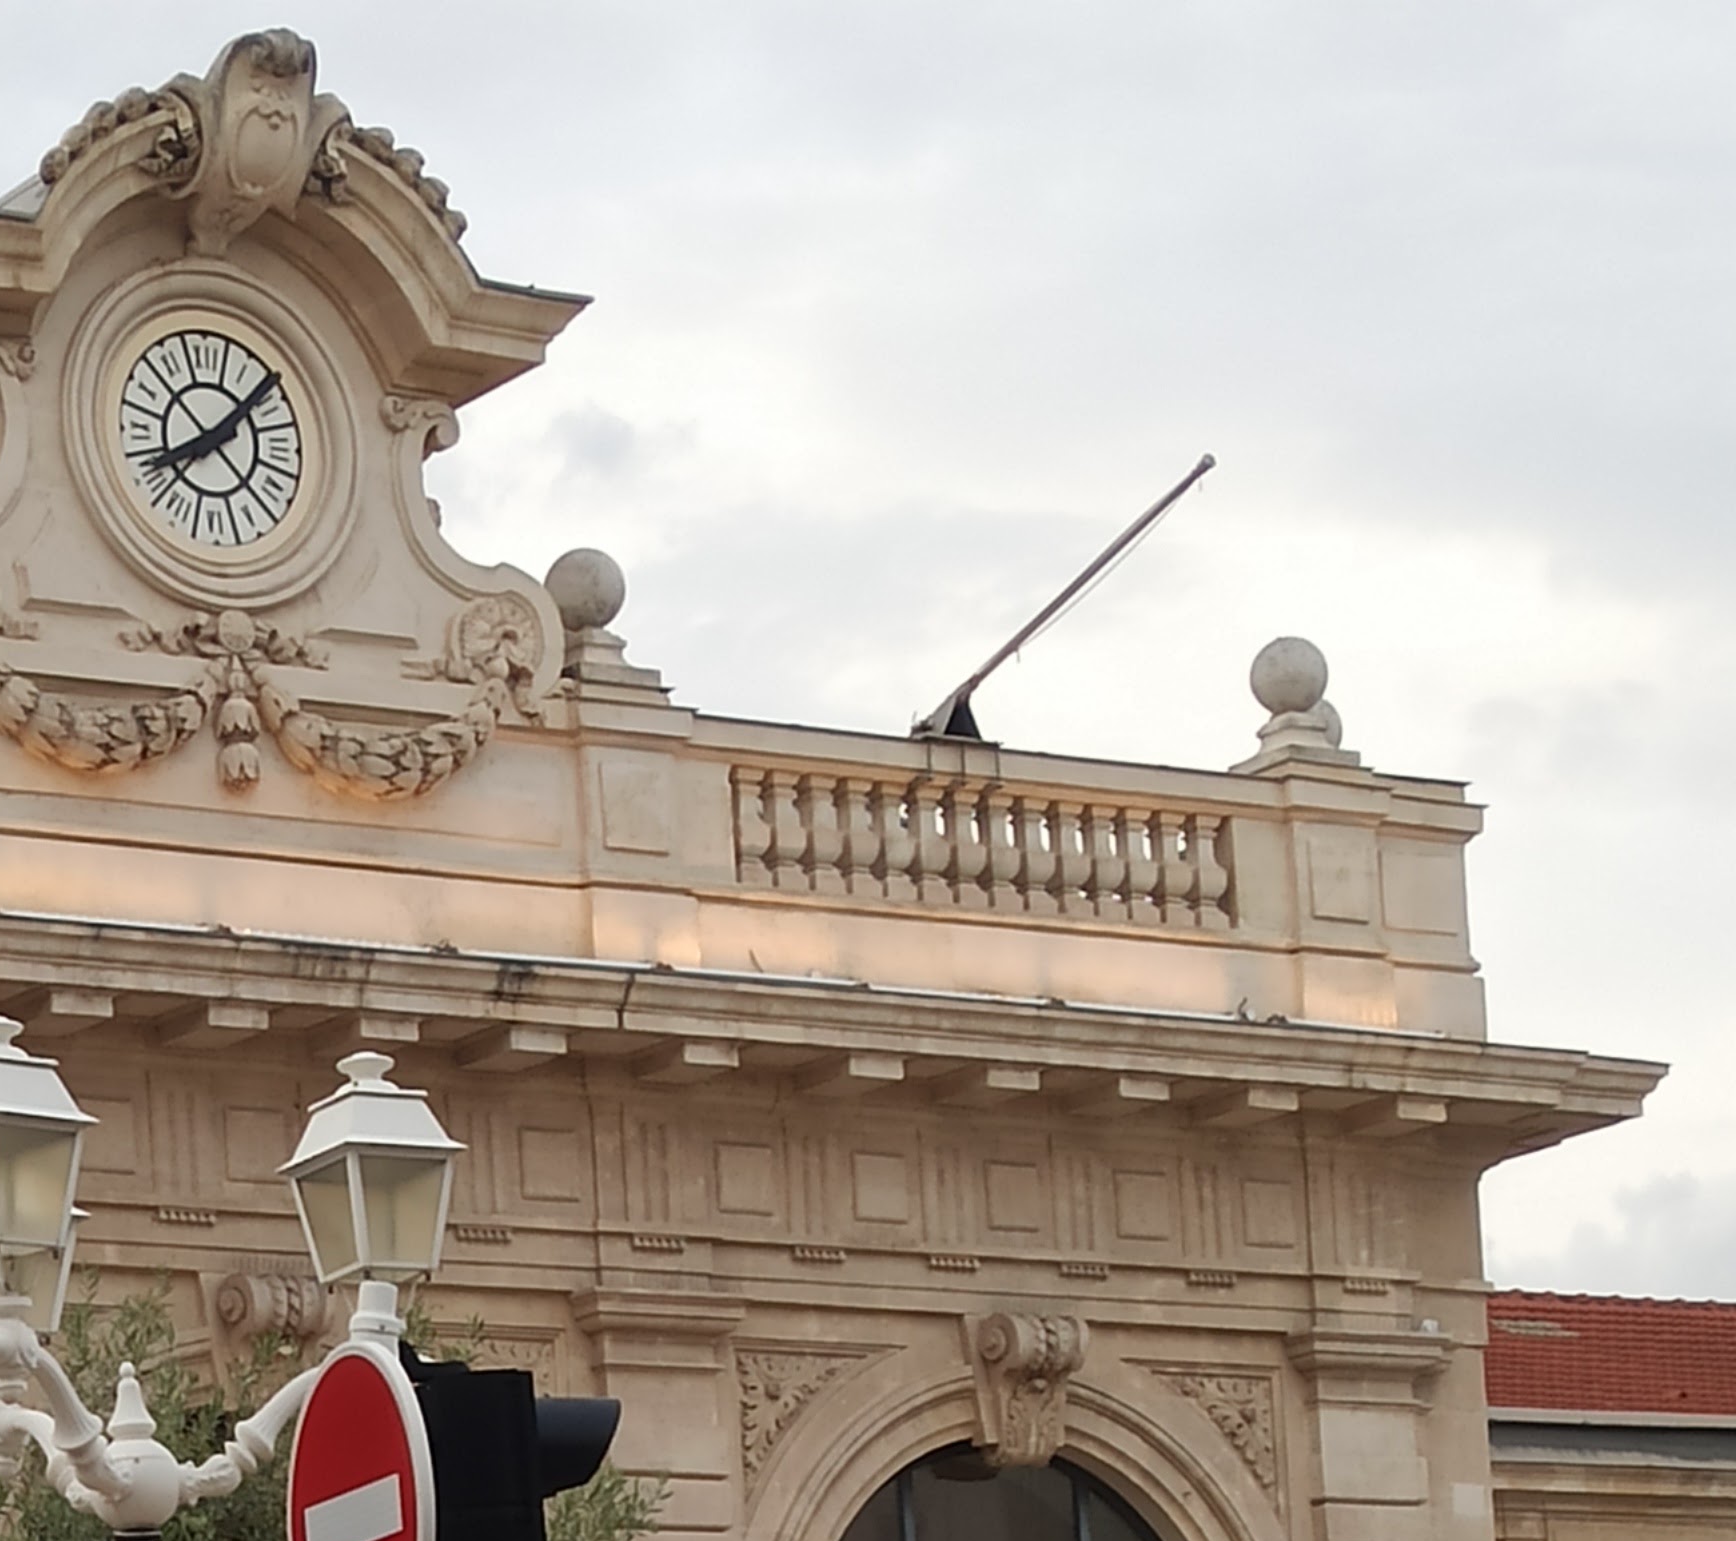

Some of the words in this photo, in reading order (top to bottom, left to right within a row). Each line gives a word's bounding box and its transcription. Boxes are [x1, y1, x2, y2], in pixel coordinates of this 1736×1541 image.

[161, 350, 181, 378] XI
[192, 344, 218, 372] XII
[138, 380, 157, 402] X
[130, 419, 152, 441] IX
[268, 436, 290, 463] III
[260, 474, 284, 504] IV
[166, 489, 192, 523] VII
[240, 504, 256, 528] V
[206, 509, 224, 536] VI
